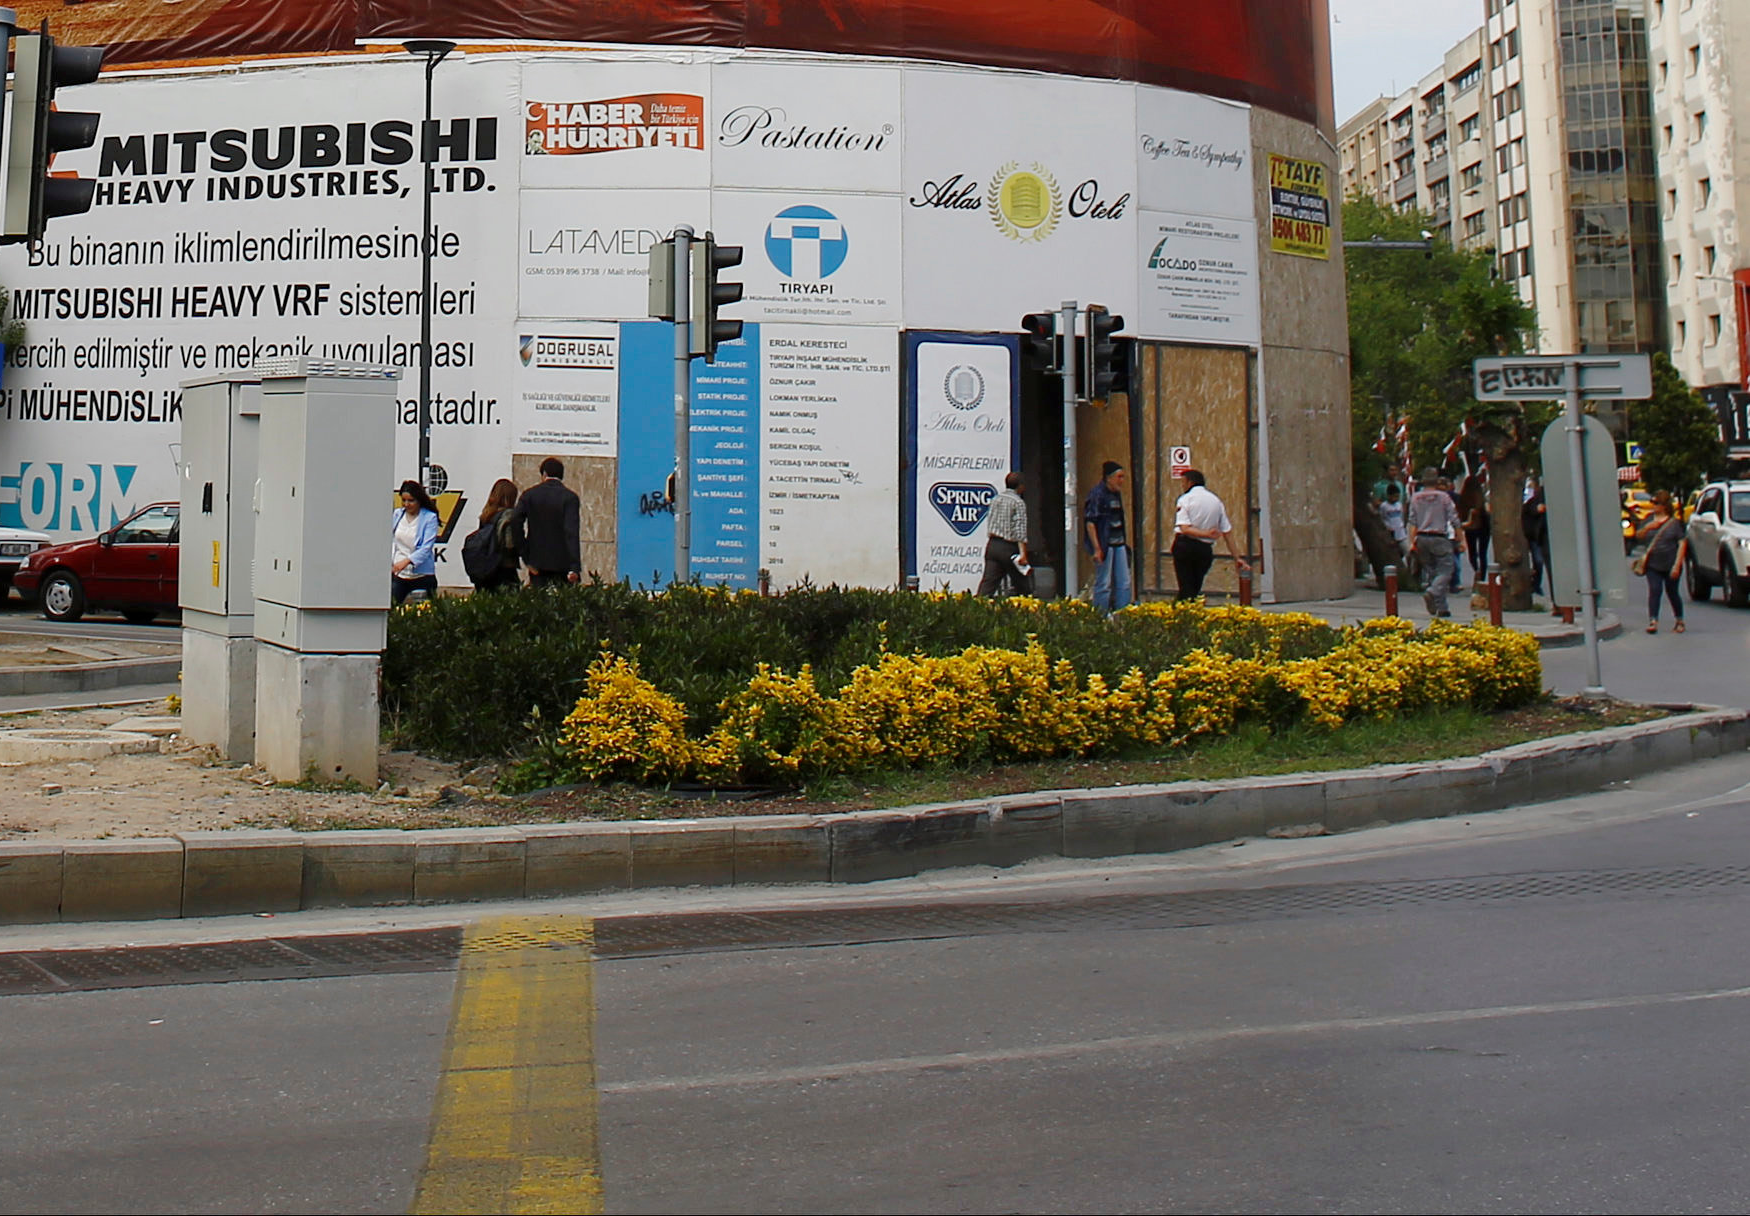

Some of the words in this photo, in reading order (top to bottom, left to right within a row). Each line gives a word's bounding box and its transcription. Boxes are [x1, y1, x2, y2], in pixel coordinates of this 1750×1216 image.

[546, 103, 644, 125] HABER
[661, 113, 686, 127] Türkiye
[686, 114, 699, 126] için
[98, 116, 498, 178] MITSUBISHI
[1285, 160, 1322, 186] TAYF
[95, 177, 195, 206] HEAVY
[206, 169, 411, 203] INDUSTRIES,
[428, 167, 496, 193] LTD.
[909, 173, 982, 212] Atlas
[1067, 179, 1131, 222] Oteli
[29, 239, 61, 267] Bu
[69, 234, 165, 267] binanın
[173, 224, 461, 266] iklimlendirilmesinde
[529, 230, 673, 255] LATAMEDY
[525, 268, 544, 276] GSM:
[546, 268, 565, 276] 0539
[779, 283, 834, 295] TIRYAPI
[12, 286, 163, 320] MITSUBISHI
[171, 284, 265, 319] HEAVY
[273, 282, 330, 317] VRF
[339, 280, 476, 317] sistemleri
[769, 339, 798, 347] ERDAL
[800, 340, 848, 349] KERESTECİ
[8, 336, 67, 369] tercih
[74, 336, 174, 378] edilmiştir
[180, 343, 207, 368] ve
[923, 412, 968, 432] Atlas
[973, 413, 1007, 433] Oteli
[922, 452, 1005, 471] MİSAFİRLERİNİ
[936, 485, 993, 506] SPRING
[929, 545, 983, 558] YATAKLARI
[922, 558, 984, 575] AĞIRLAYACA
